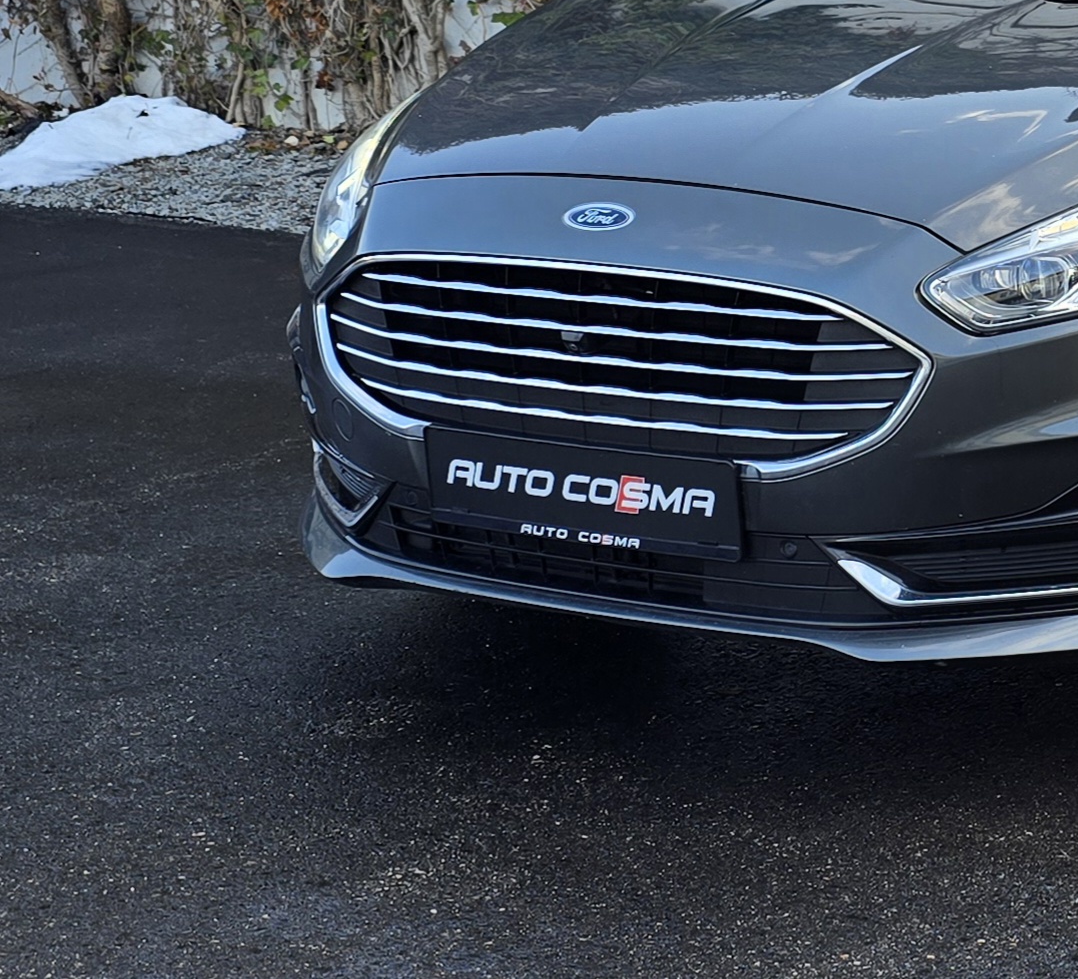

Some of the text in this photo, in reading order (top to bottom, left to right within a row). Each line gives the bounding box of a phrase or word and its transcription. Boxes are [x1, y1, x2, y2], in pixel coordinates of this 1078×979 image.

[577, 208, 618, 224] Ford
[447, 459, 715, 516] AUTO COSMA
[520, 524, 640, 549] AUTO COSMA
